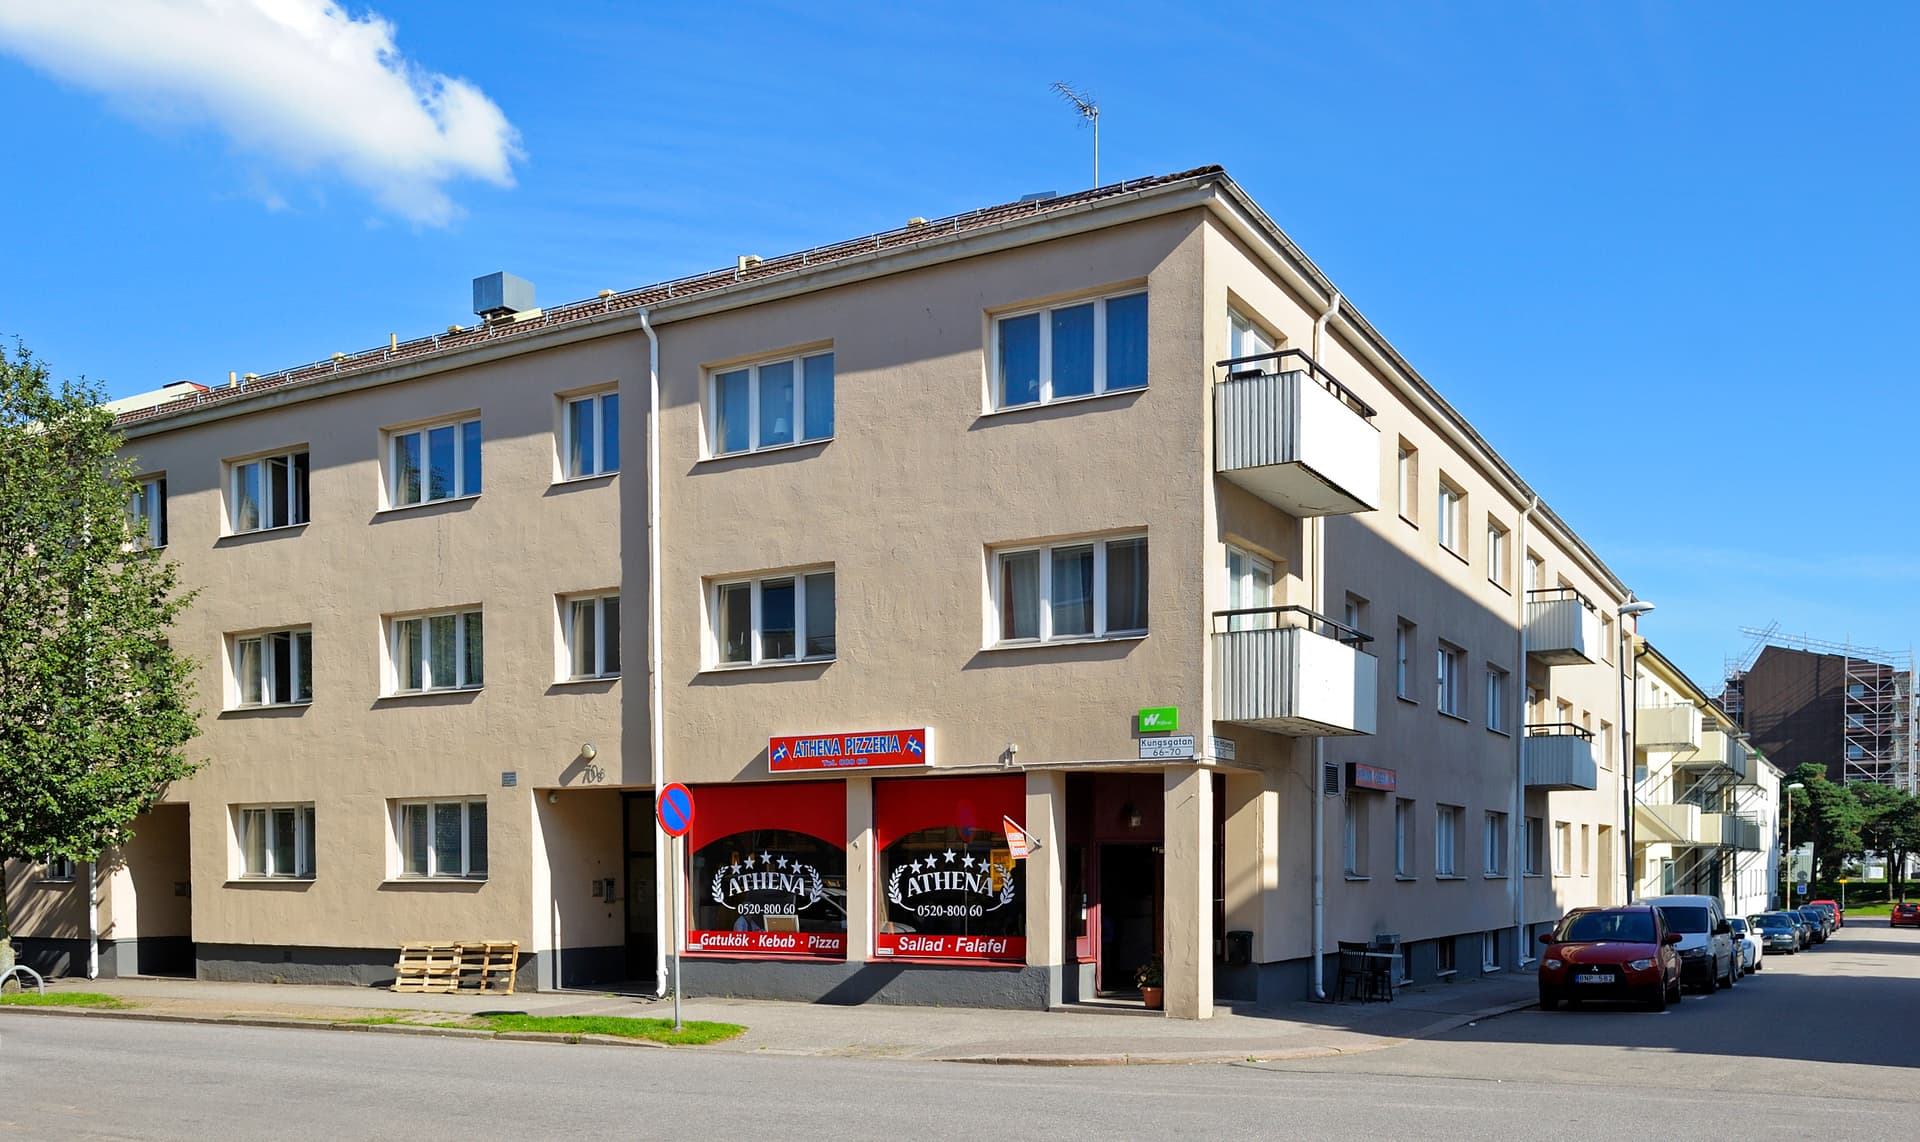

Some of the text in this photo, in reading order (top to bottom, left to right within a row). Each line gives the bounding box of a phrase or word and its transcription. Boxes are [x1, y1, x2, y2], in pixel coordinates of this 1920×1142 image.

[792, 734, 901, 759] ATHENA PIZZERIA
[1141, 738, 1193, 748] Kungsgatan
[1153, 748, 1181, 757] 66-70
[729, 872, 805, 897] ATHENA
[907, 870, 994, 898] ATHENA
[737, 903, 796, 915] 0520-800 60
[917, 904, 983, 917] 0520-800 60
[700, 933, 840, 949] Gatukök Kebab Pizza
[898, 936, 1007, 953] Sallad Falafel
